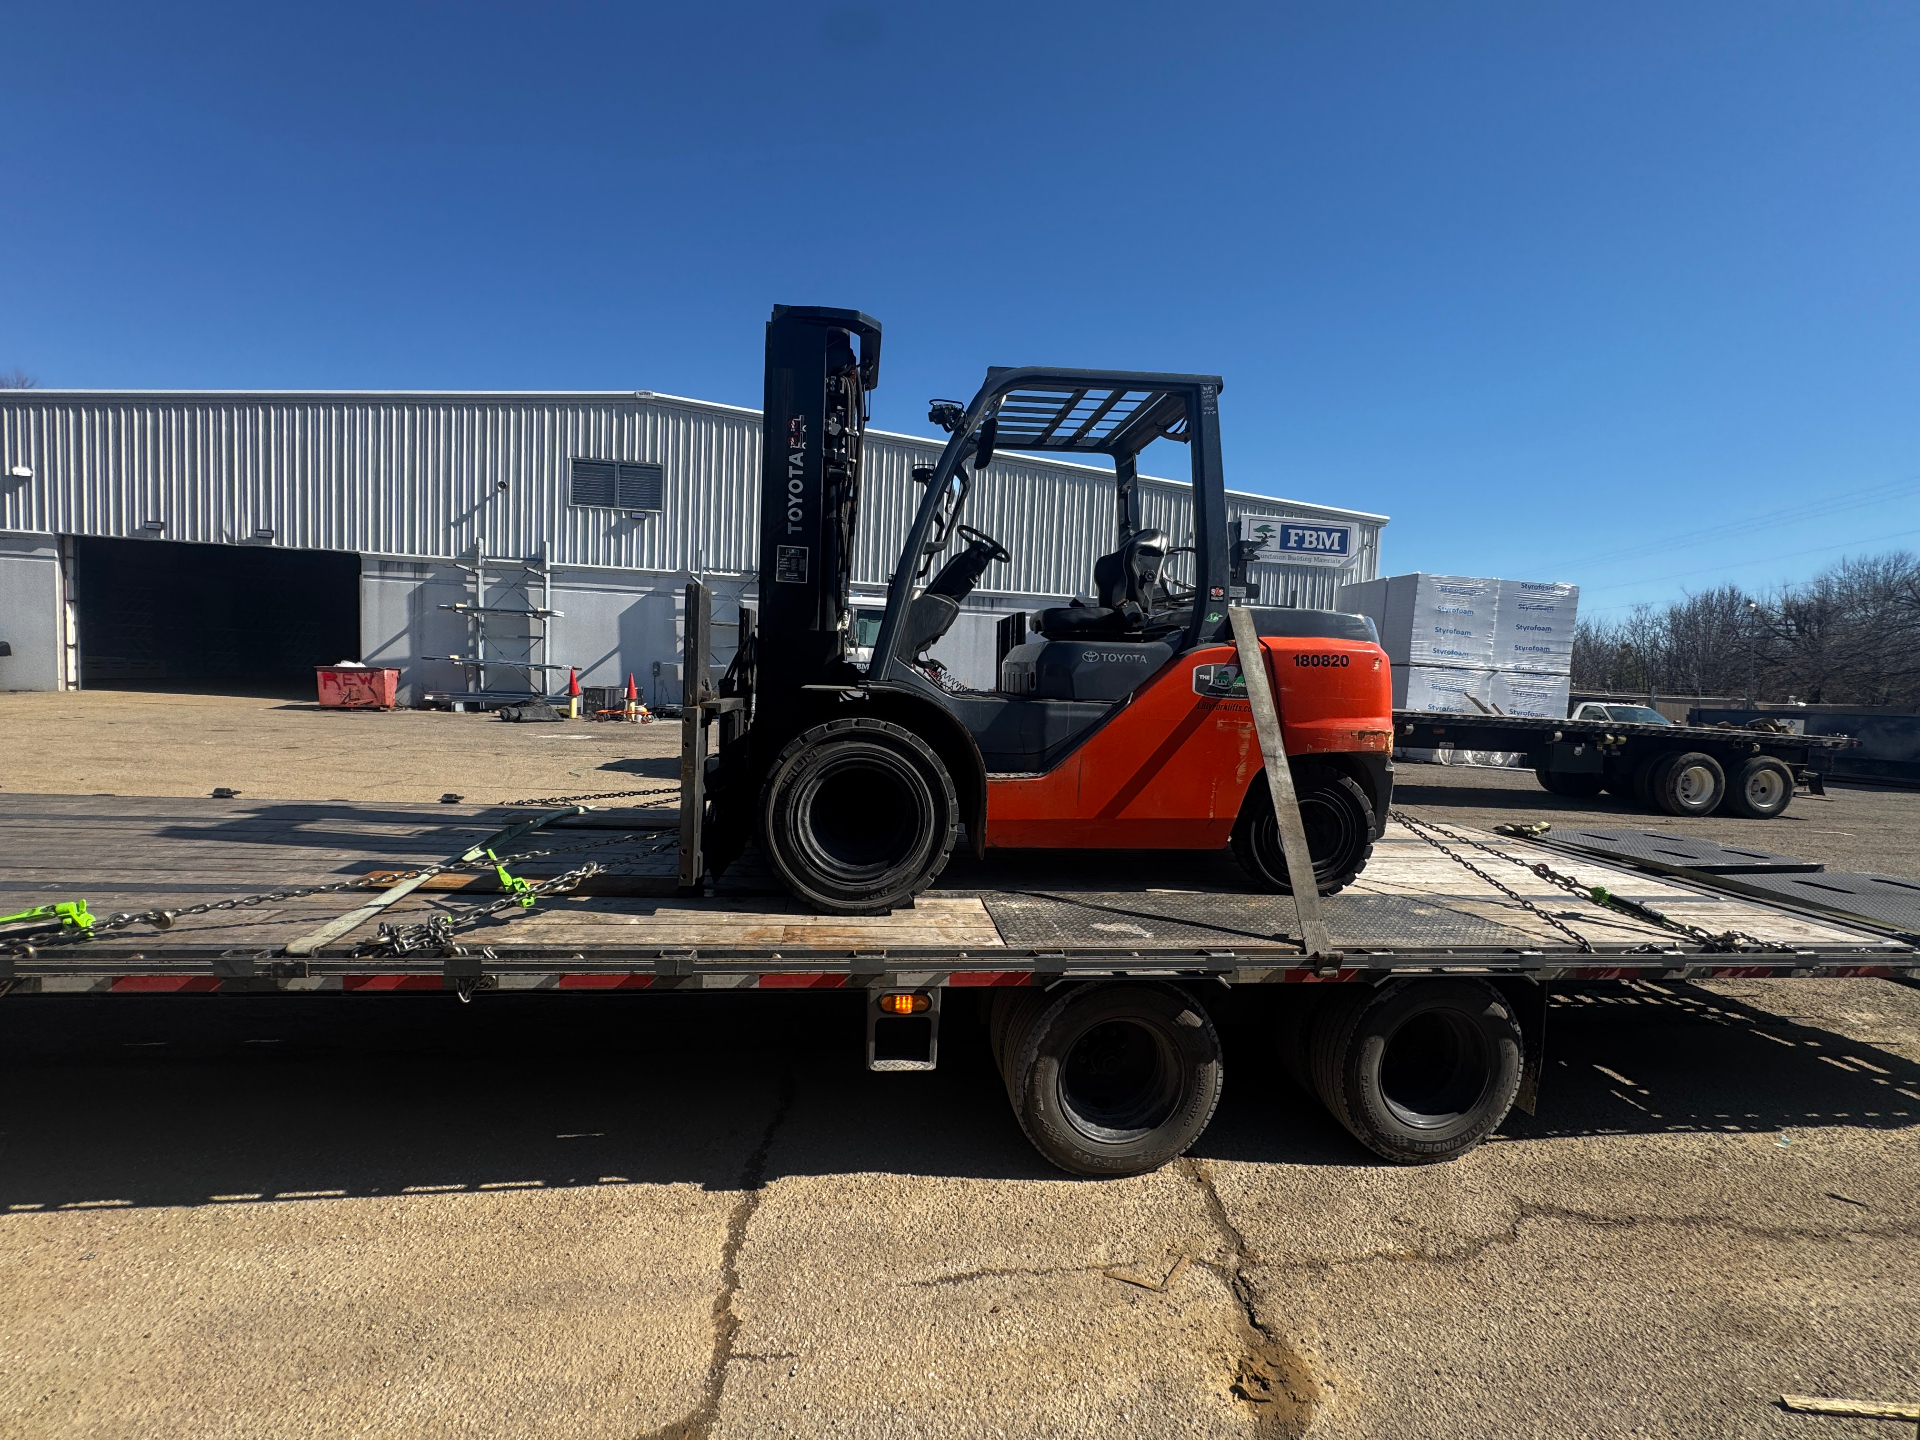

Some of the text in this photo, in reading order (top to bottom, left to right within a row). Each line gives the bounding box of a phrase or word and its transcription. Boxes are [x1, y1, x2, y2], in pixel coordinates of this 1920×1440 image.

[788, 452, 804, 534] TOYOTA
[1287, 528, 1341, 551] FBM
[1287, 554, 1312, 564] Building
[1313, 556, 1341, 565] Materials
[1521, 582, 1555, 591] Styrofoam
[1437, 605, 1474, 615] Styrofoam
[1434, 626, 1471, 636] Styrofoam
[1515, 624, 1552, 632] Styrofoam
[1432, 647, 1469, 657] Styrofoam
[1514, 644, 1550, 653] Styrofoam
[1101, 653, 1147, 664] TOYOTA
[1293, 654, 1349, 667] 180820
[321, 672, 374, 690] REW
